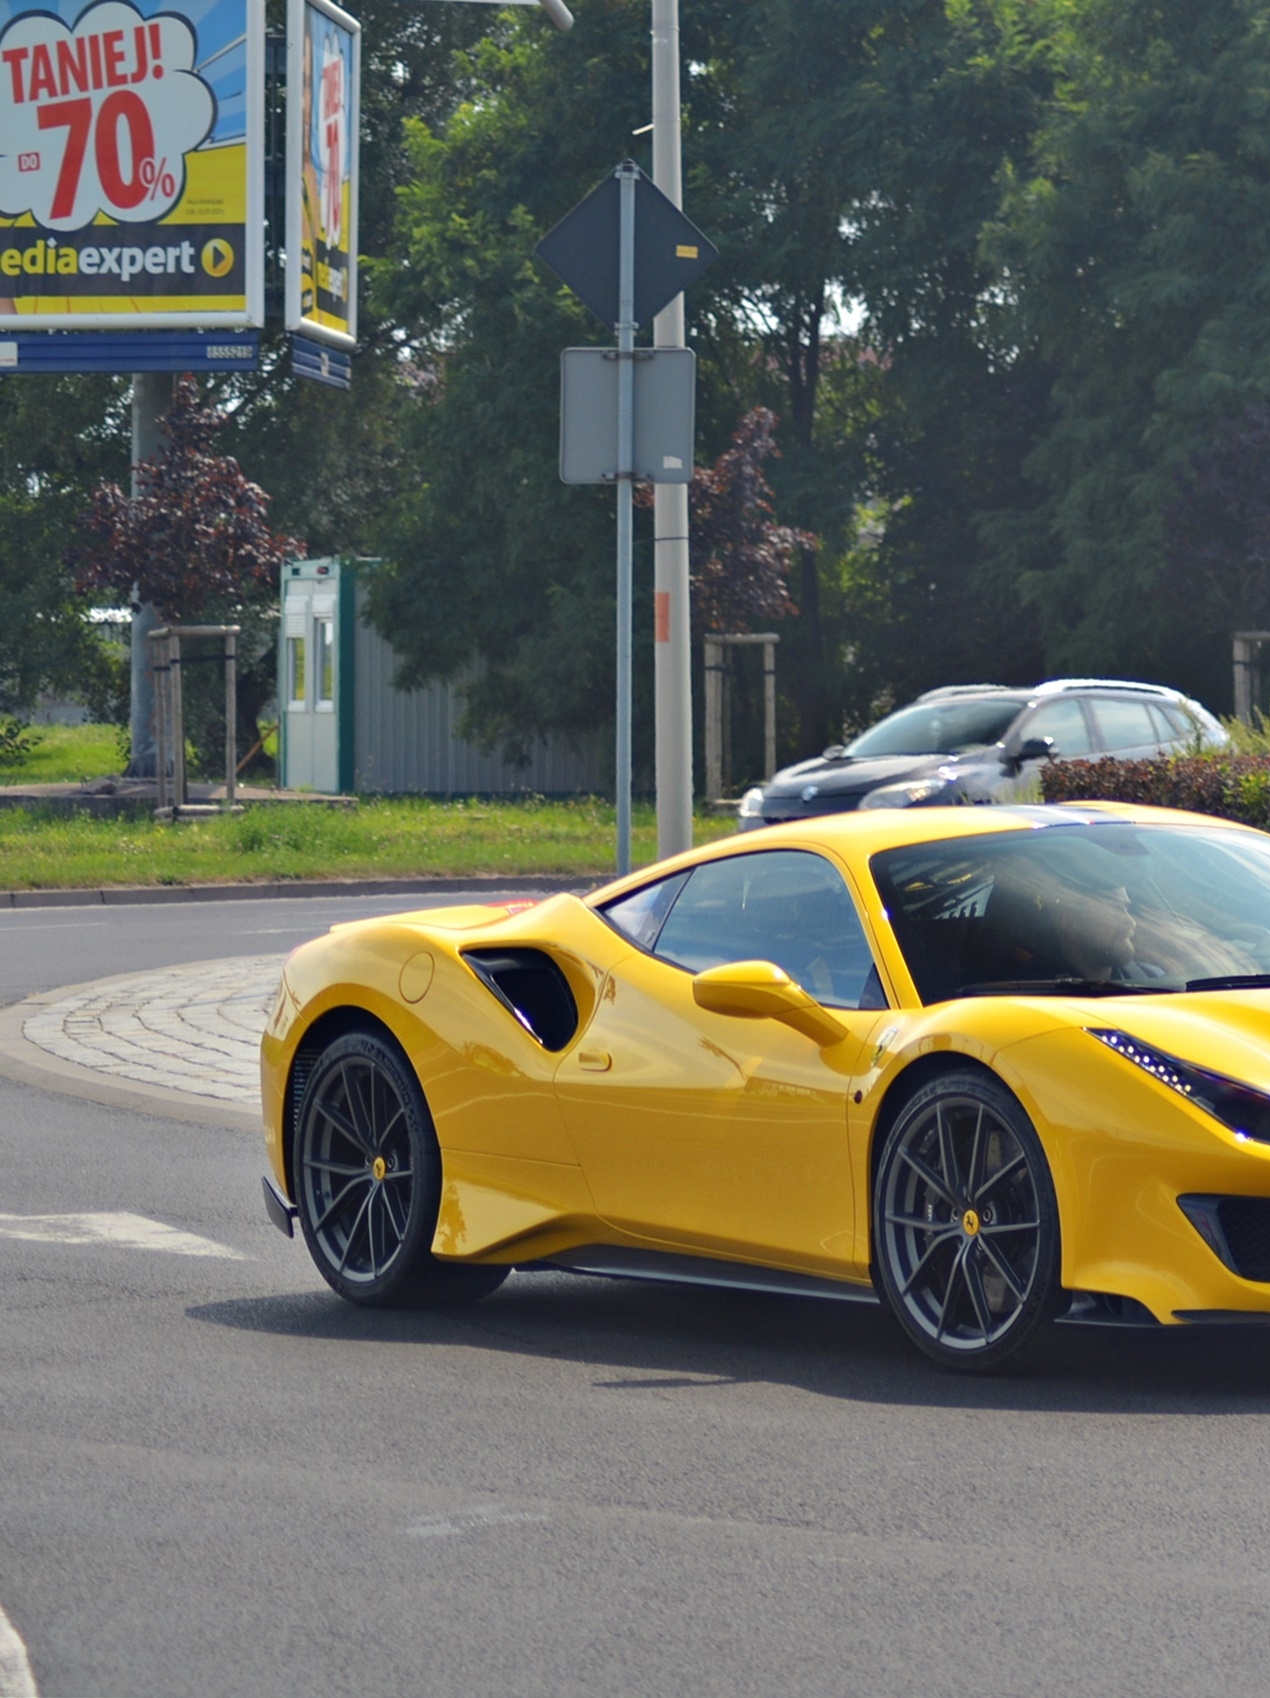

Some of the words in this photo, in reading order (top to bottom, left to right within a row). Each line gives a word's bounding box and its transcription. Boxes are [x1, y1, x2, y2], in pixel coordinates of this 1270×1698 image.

[2, 23, 164, 104] TANIEJ!
[19, 153, 39, 171] DO
[0, 237, 195, 281] ediaexpert
